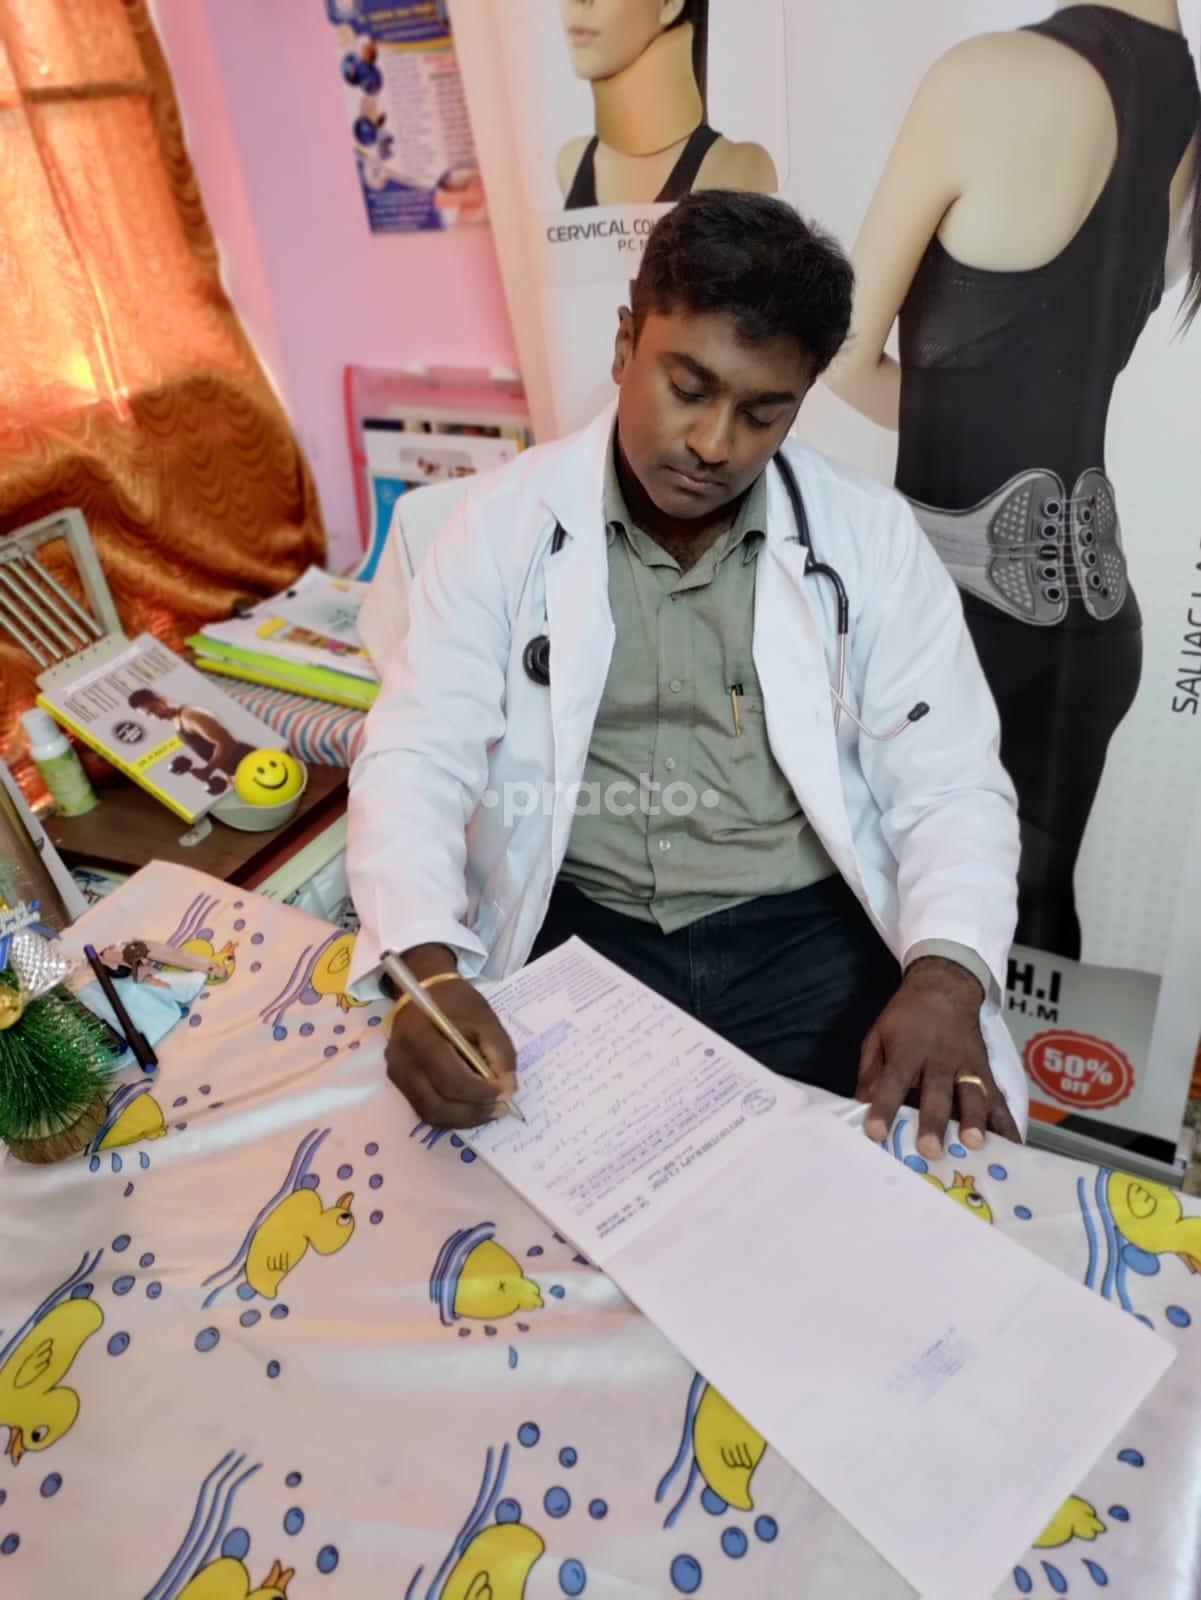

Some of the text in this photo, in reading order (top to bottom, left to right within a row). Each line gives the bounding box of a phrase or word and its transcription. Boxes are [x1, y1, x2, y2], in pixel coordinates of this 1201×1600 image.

[546, 219, 630, 243] CERVICAL
[1043, 1048, 1113, 1085] 50%
[1060, 1077, 1090, 1096] OFF
